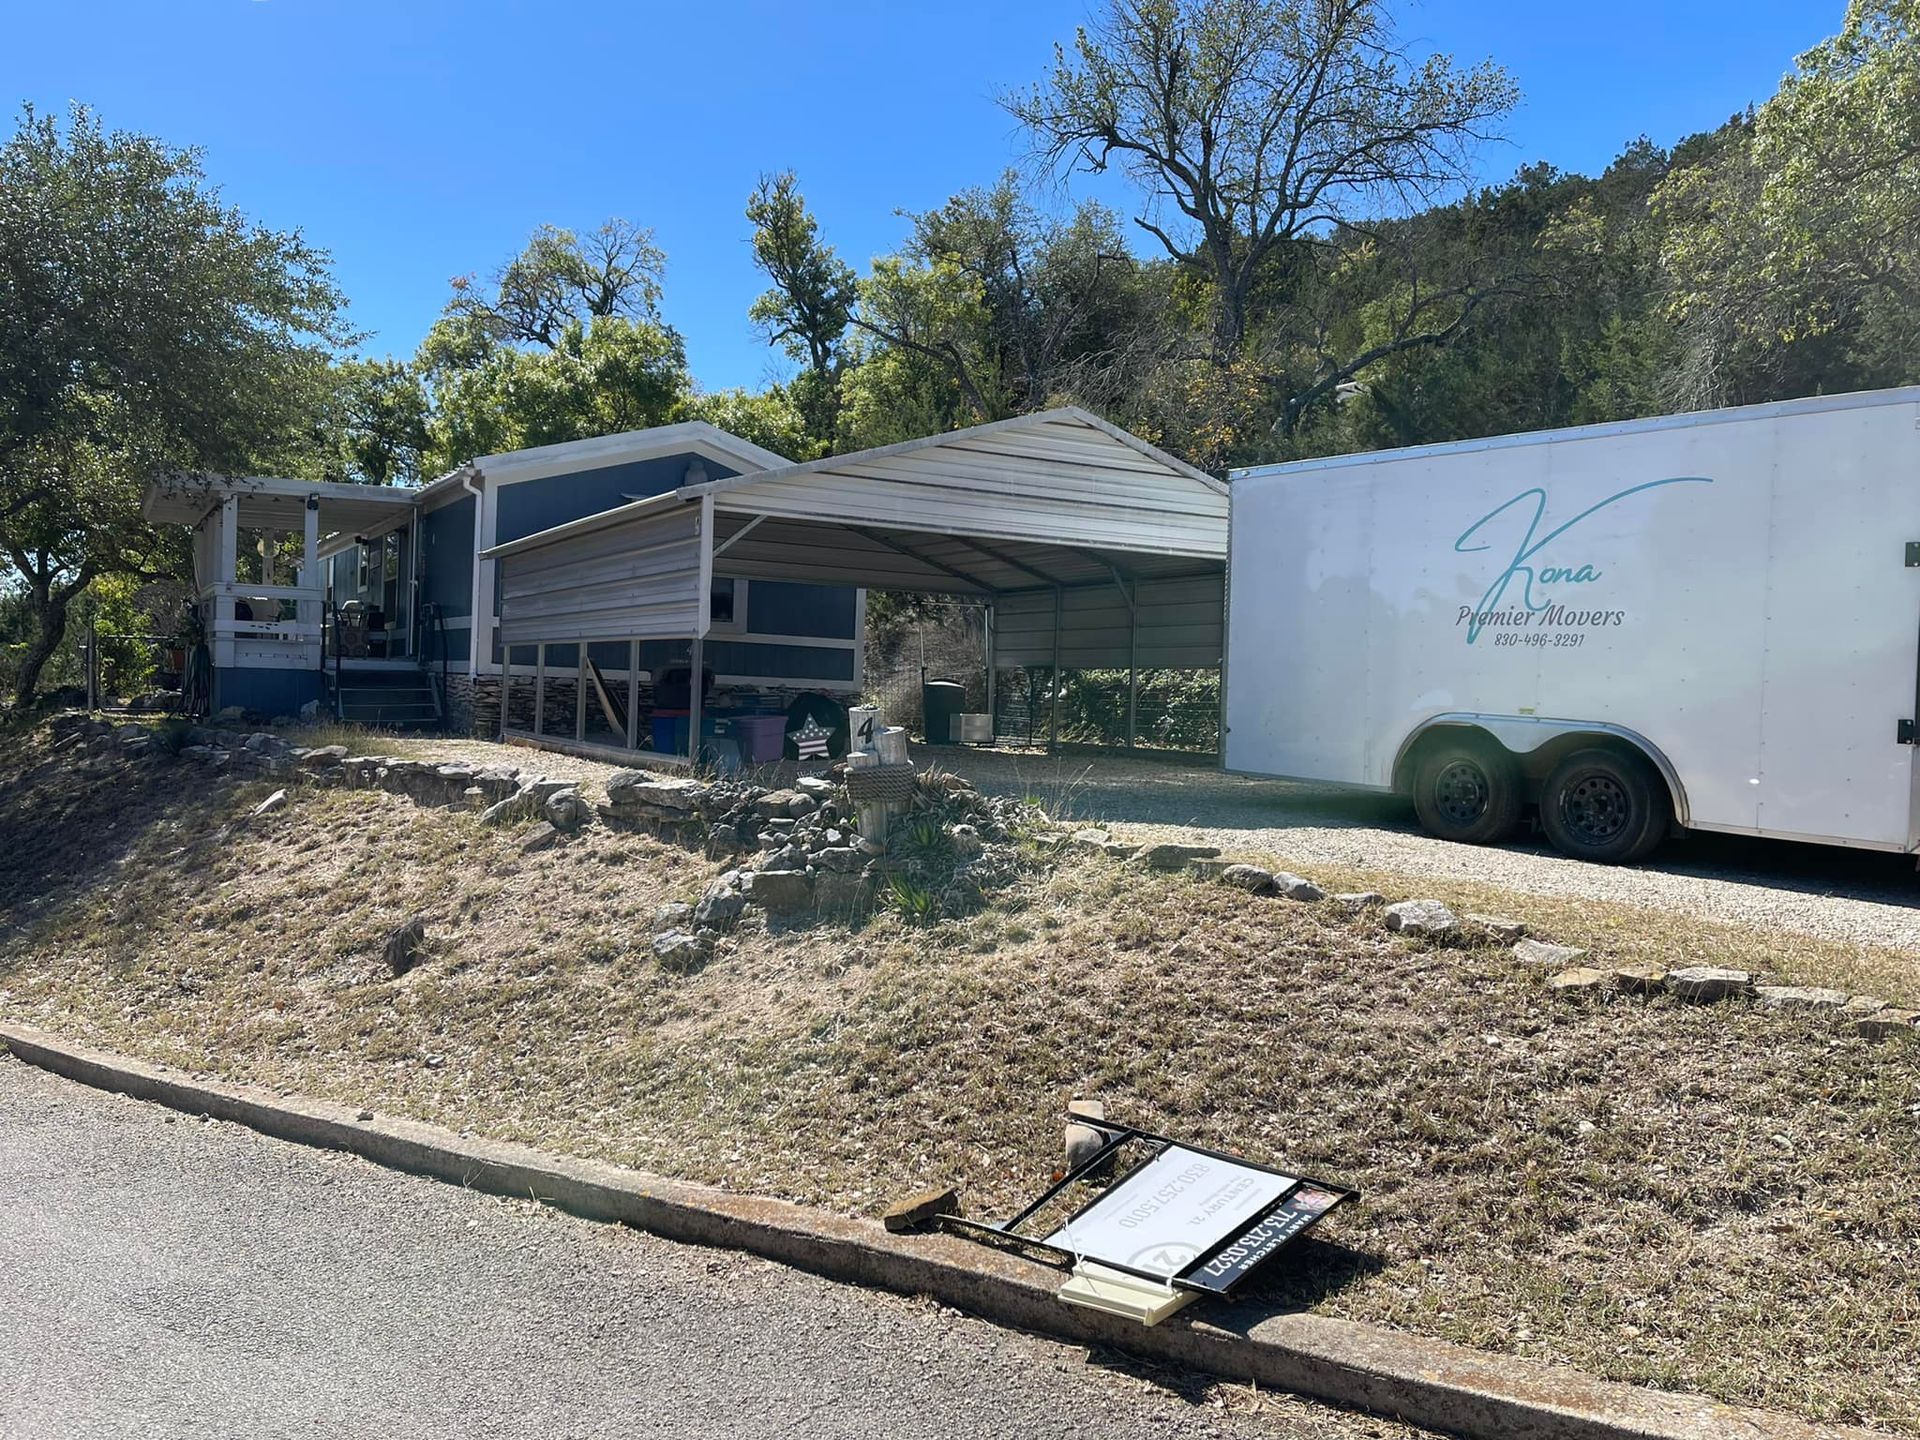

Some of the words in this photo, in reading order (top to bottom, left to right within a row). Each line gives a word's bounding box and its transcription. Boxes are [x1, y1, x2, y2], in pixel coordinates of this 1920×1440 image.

[1454, 476, 1714, 645] Kona
[1455, 604, 1536, 627] Premier
[1538, 603, 1626, 627] Movers
[1494, 632, 1586, 648] 830-496-3291
[857, 716, 874, 745] 4
[1118, 1163, 1211, 1229] 830.257.5010
[1203, 1177, 1255, 1217] CENTURY
[1203, 1208, 1298, 1277] 713.213.0327
[1285, 1214, 1313, 1235] MARY
[1237, 1234, 1288, 1270] FLETCHER
